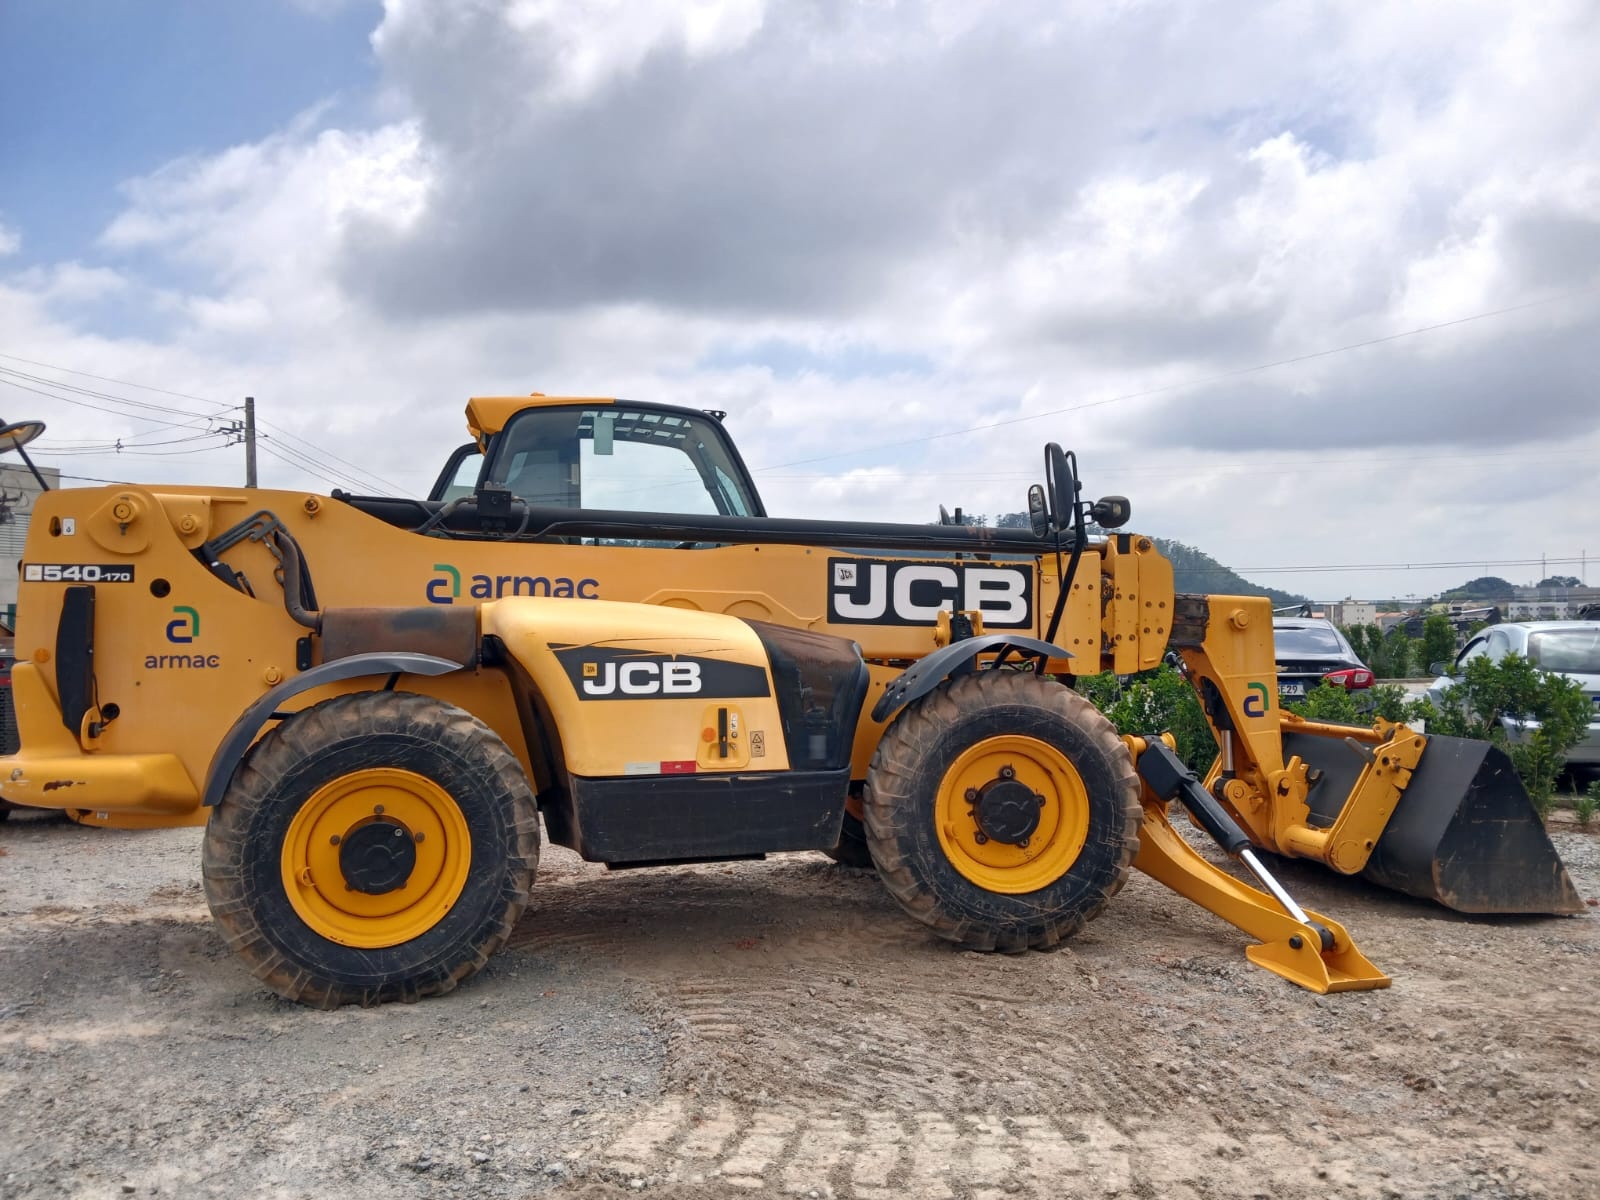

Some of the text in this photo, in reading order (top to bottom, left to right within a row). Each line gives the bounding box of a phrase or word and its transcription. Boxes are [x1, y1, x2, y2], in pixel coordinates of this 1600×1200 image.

[43, 565, 131, 581] 540-170
[470, 574, 600, 600] armac
[834, 563, 1028, 624] JCB
[144, 654, 220, 669] armac
[583, 661, 702, 695] JCB
